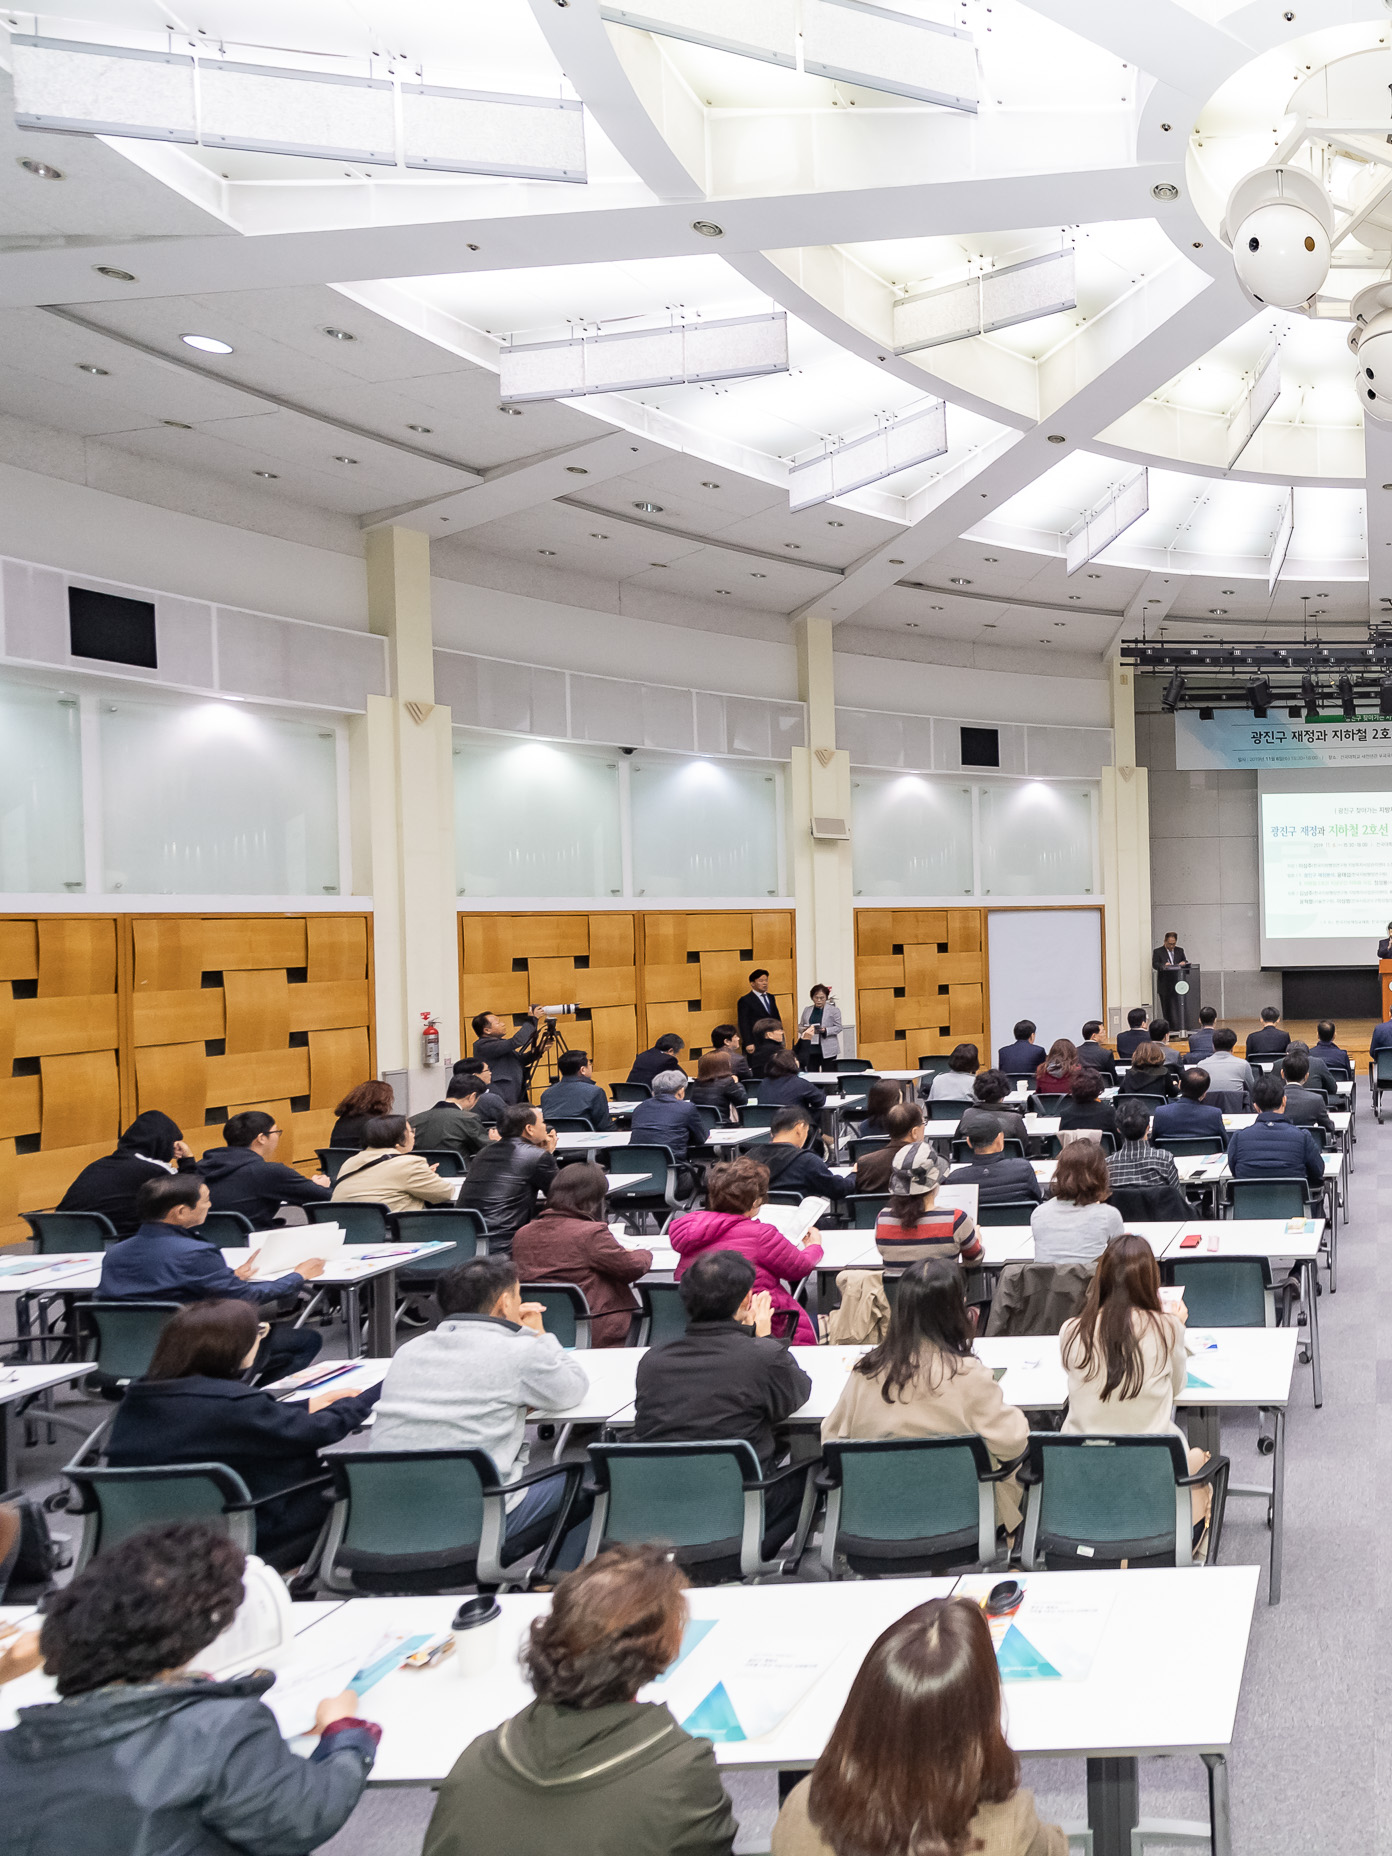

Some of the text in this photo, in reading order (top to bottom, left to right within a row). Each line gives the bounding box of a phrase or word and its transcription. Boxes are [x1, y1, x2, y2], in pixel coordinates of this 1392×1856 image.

[1251, 730, 1287, 745] 광진구
[1291, 730, 1328, 743] 재정과
[1332, 728, 1368, 742] 지하철
[1270, 826, 1297, 838] 광진구
[1300, 825, 1325, 837] 재정과
[1328, 823, 1359, 837] 지하철
[1362, 823, 1388, 837] 2호선
